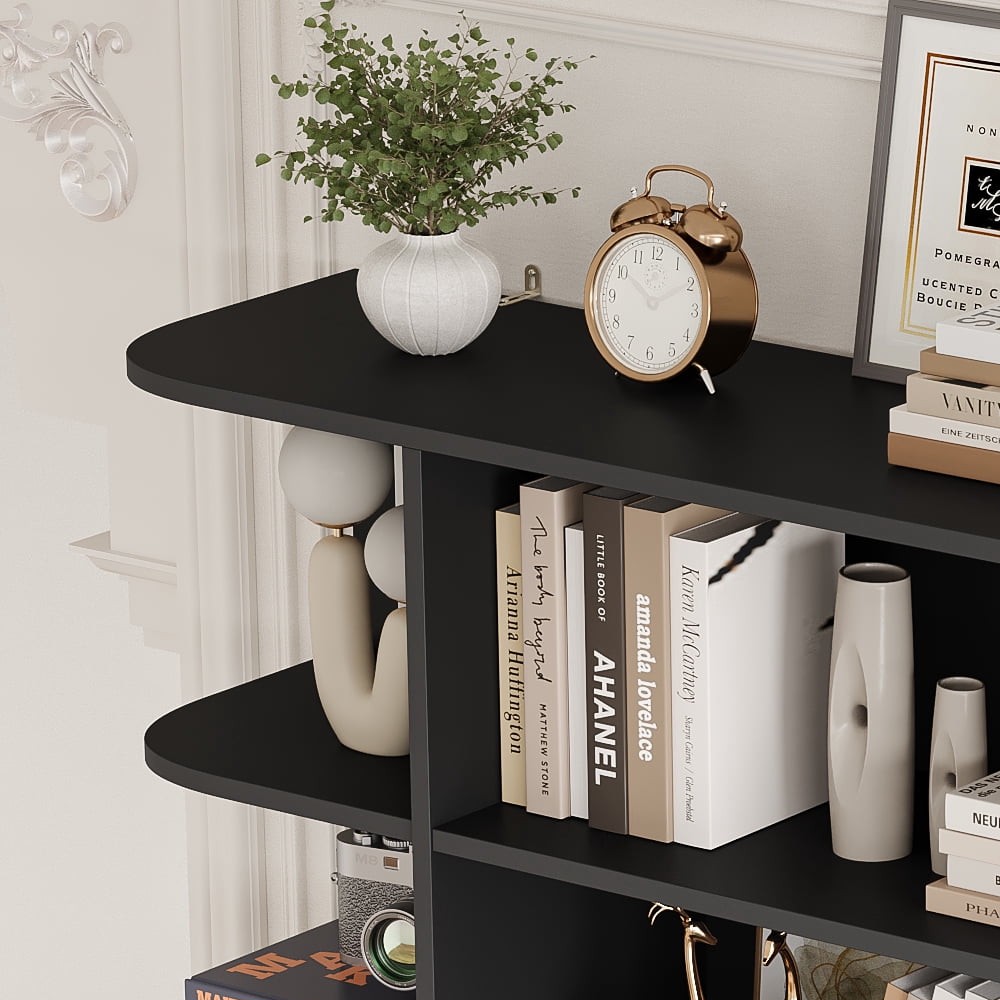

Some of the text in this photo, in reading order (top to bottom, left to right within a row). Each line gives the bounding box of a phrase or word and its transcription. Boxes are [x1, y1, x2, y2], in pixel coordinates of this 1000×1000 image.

[633, 249, 643, 264] 11
[651, 246, 664, 261] 12
[617, 265, 628, 280] 10
[687, 277, 695, 292] 2
[608, 288, 616, 303] 9
[690, 303, 699, 318] 3
[612, 314, 620, 329] 8
[627, 335, 635, 350] 7
[682, 328, 690, 342] 4
[646, 346, 654, 361] 6
[668, 342, 676, 357] 5
[941, 427, 963, 438] EINE
[530, 516, 548, 557] The
[596, 534, 606, 623] LITTLE BOOK OF
[505, 566, 522, 642] Arianna
[677, 564, 701, 705] Karen McCartney
[636, 593, 657, 762] amanda lovelace
[593, 650, 617, 786] AHANEL
[539, 703, 549, 797] MATTHEW STONE
